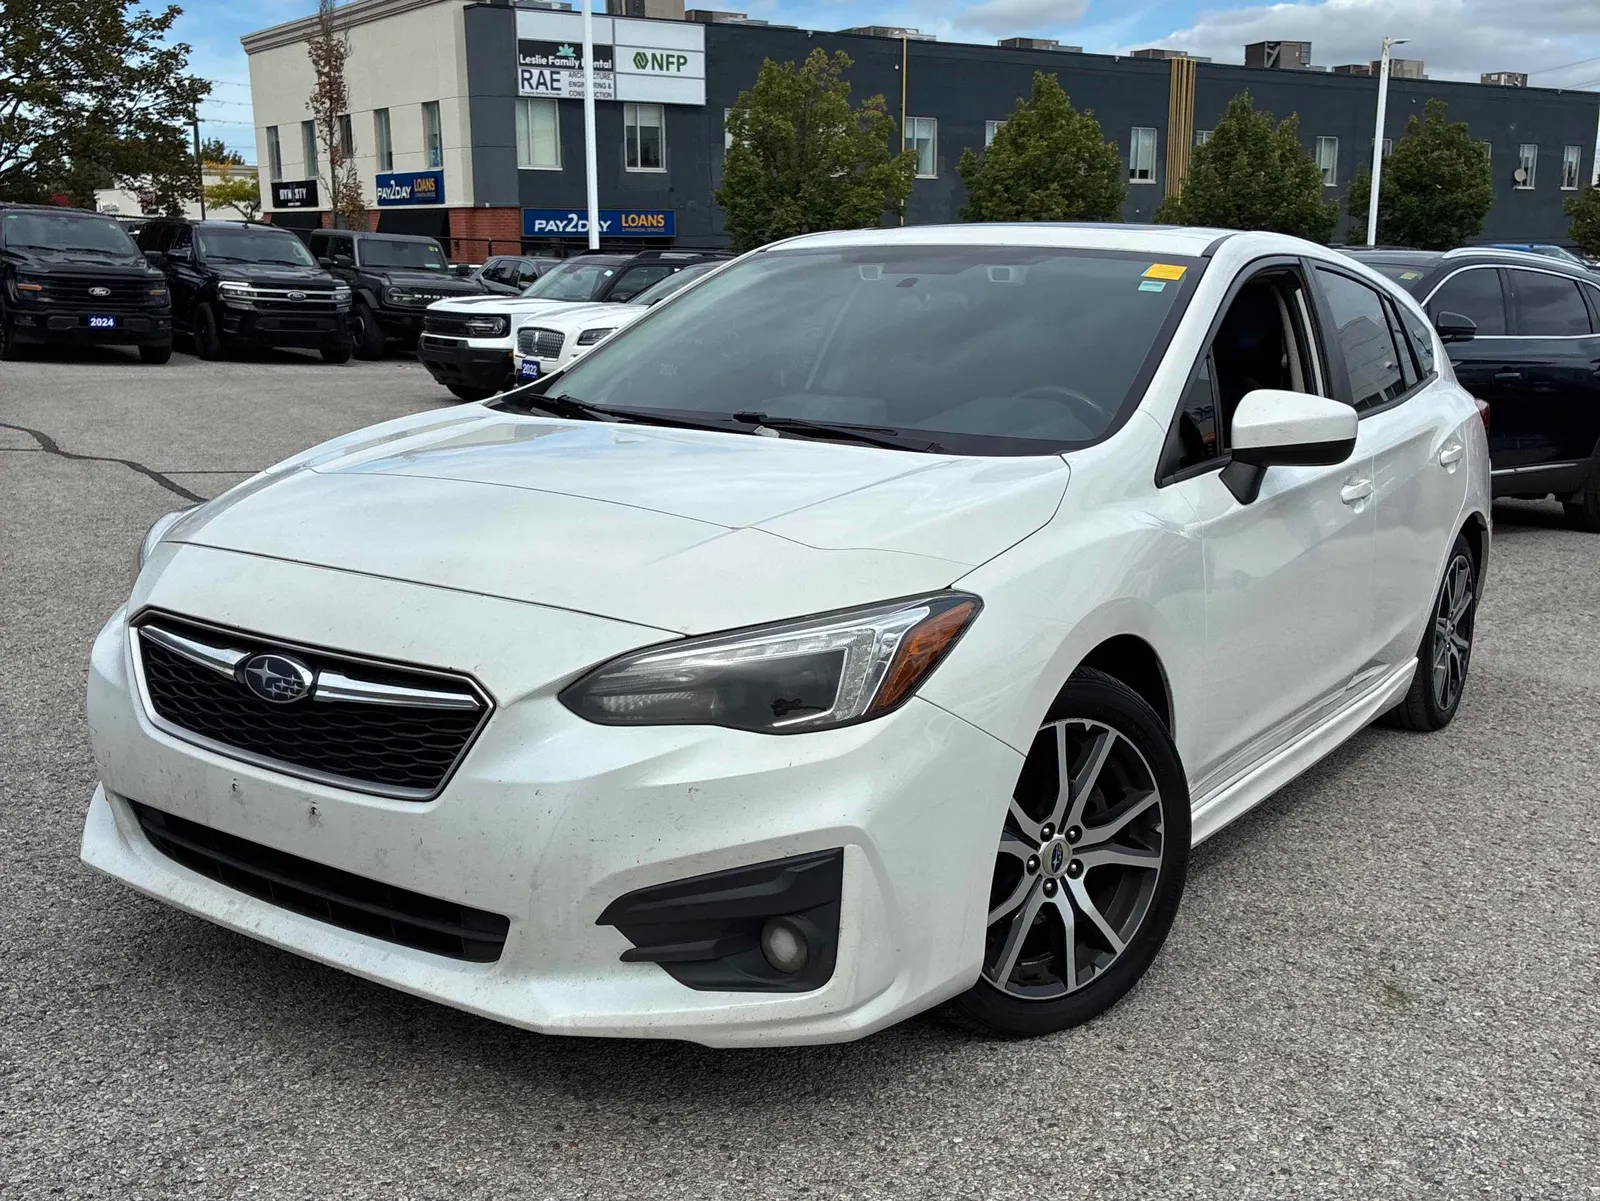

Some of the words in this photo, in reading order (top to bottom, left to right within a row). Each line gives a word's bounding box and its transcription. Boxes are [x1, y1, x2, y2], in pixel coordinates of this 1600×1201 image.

[520, 54, 547, 65] Leslie
[548, 56, 580, 68] Family
[581, 58, 612, 69] ntal
[651, 53, 688, 72] NFP
[521, 69, 561, 91] RAE
[569, 80, 606, 89] ENGIRING
[569, 90, 612, 98] CONSCTION
[377, 180, 411, 200] PAY2DAY
[413, 178, 436, 191] LOANS
[534, 213, 612, 232] PAY2DY
[621, 214, 665, 227] LOANS
[90, 317, 114, 327] 2024
[522, 363, 537, 375] 2022
